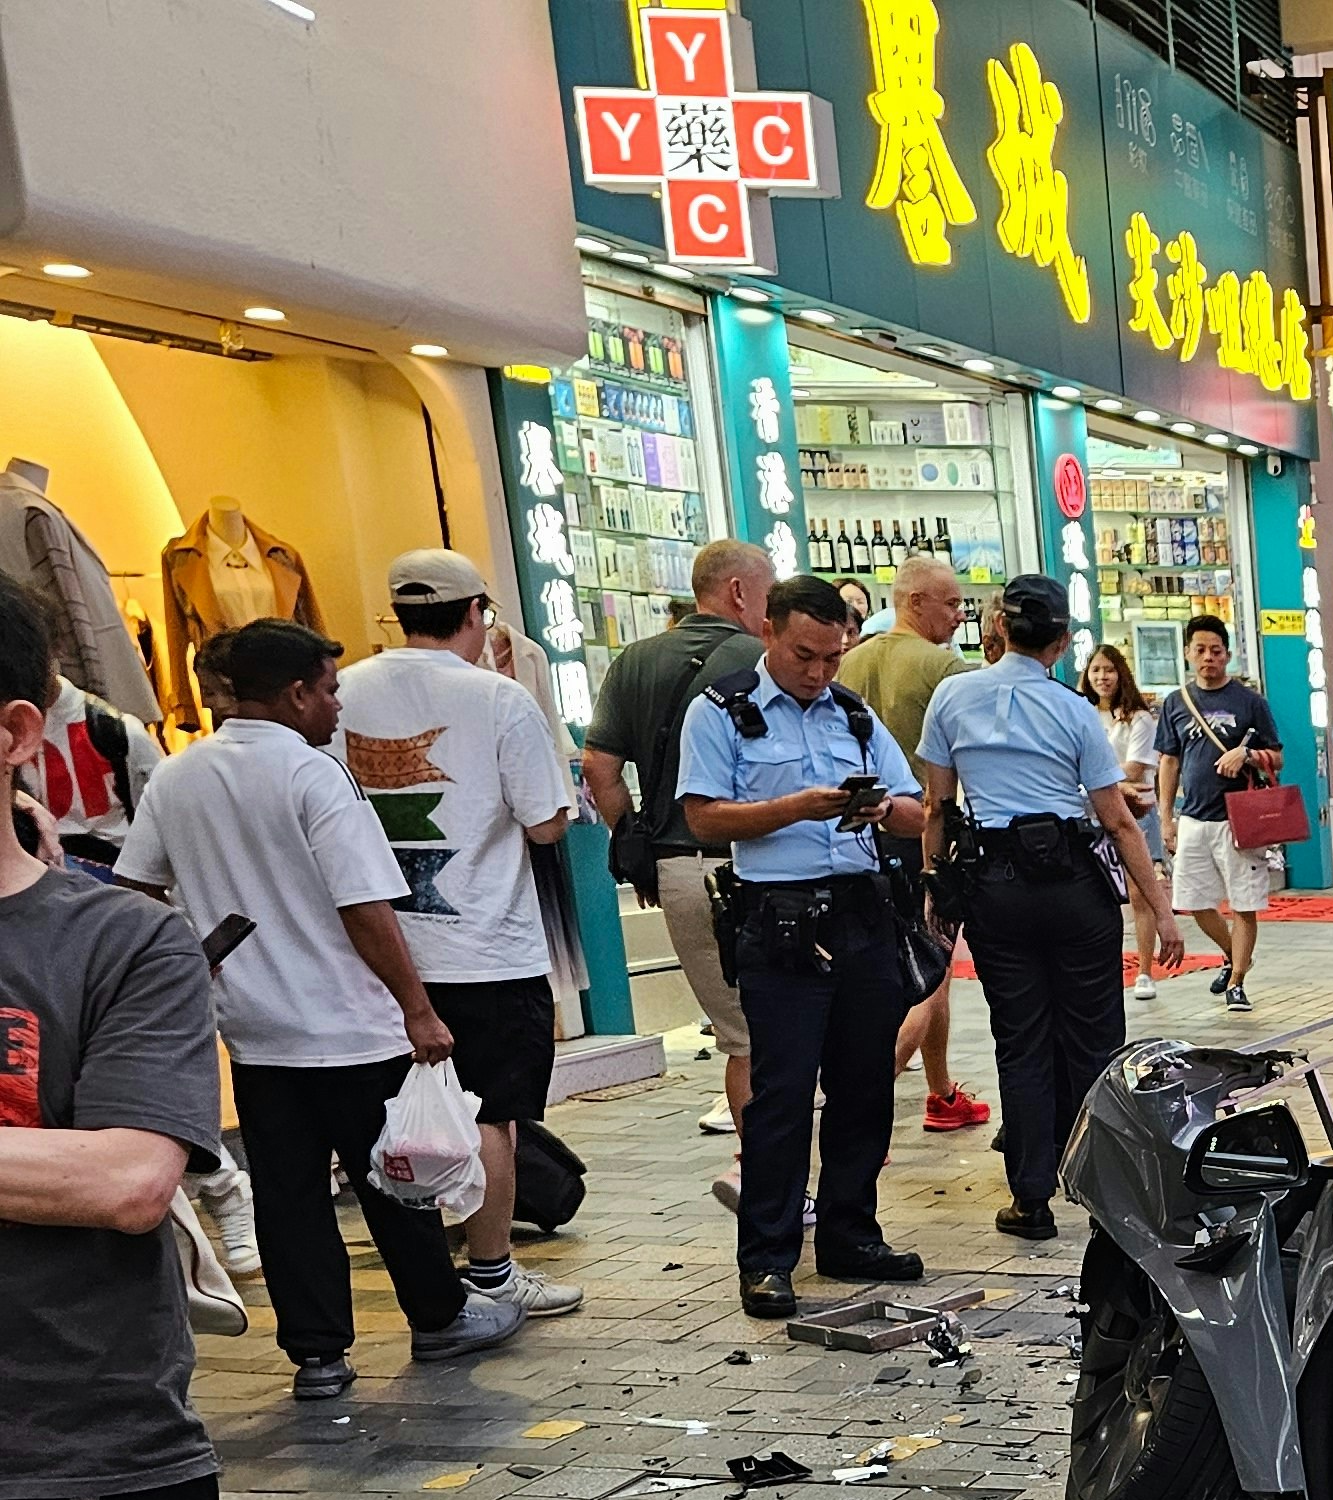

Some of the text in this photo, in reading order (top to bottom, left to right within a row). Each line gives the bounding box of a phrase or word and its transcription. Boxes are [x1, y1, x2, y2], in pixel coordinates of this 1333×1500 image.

[666, 32, 706, 81] Y
[602, 112, 641, 161] Y
[663, 102, 733, 172] 藥
[753, 114, 794, 166] C
[689, 192, 727, 244] C
